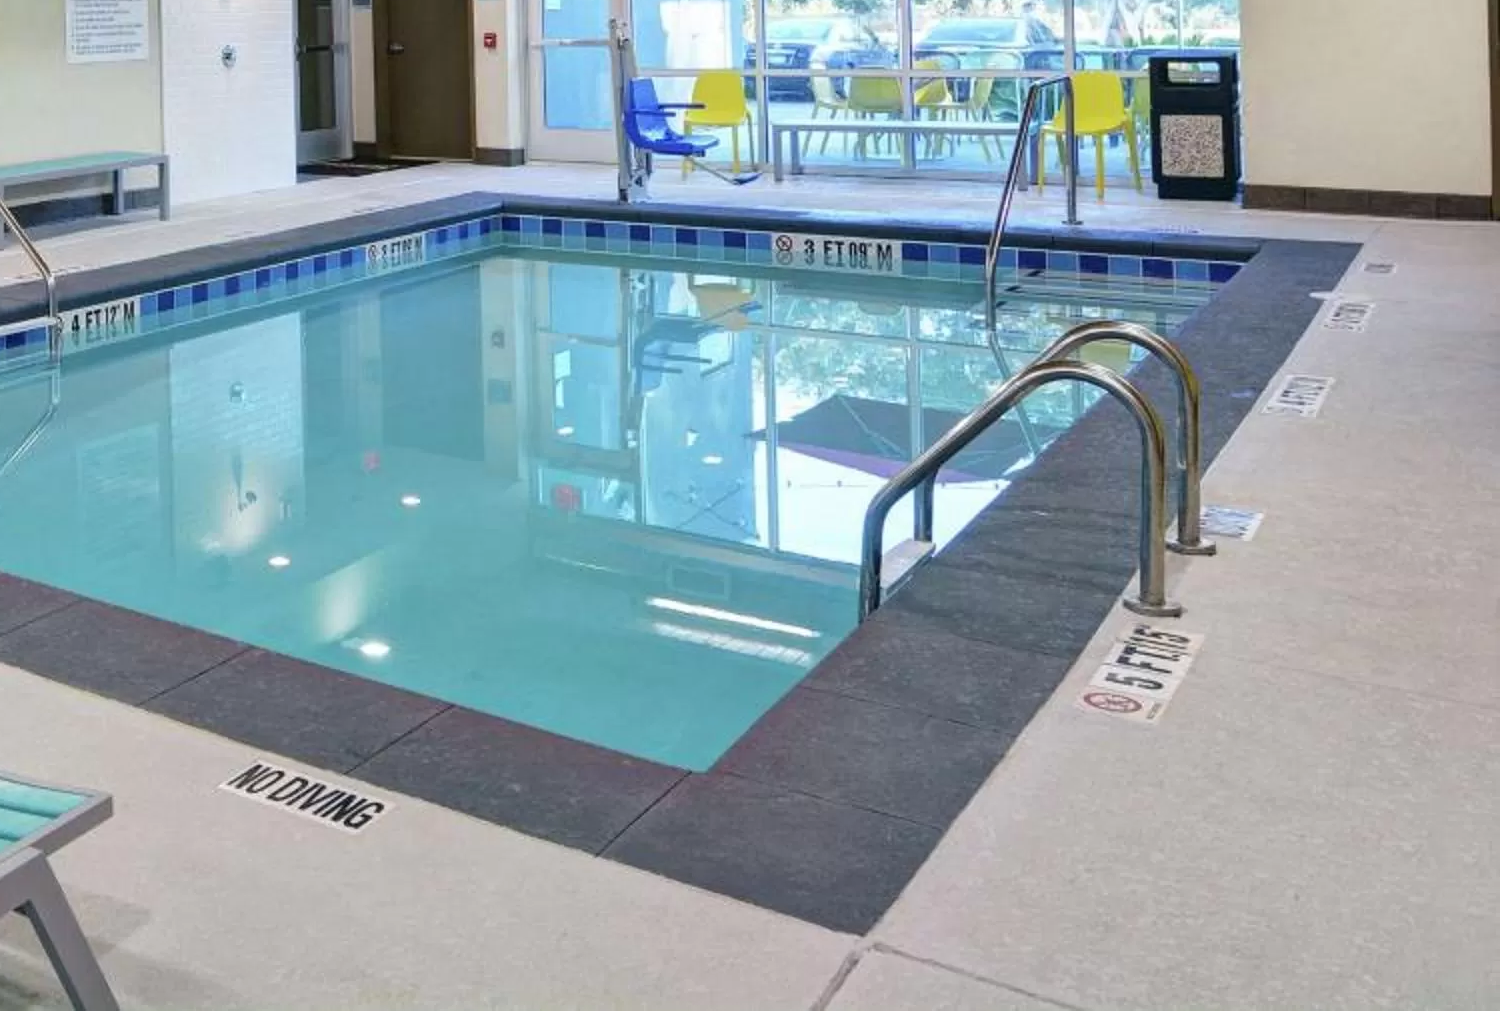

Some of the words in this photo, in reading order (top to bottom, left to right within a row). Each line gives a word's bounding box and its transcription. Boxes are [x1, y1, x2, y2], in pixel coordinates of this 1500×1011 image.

[71, 313, 80, 331] 4
[1103, 672, 1164, 690] 5
[226, 763, 285, 794] NO
[266, 776, 386, 830] DIVING
